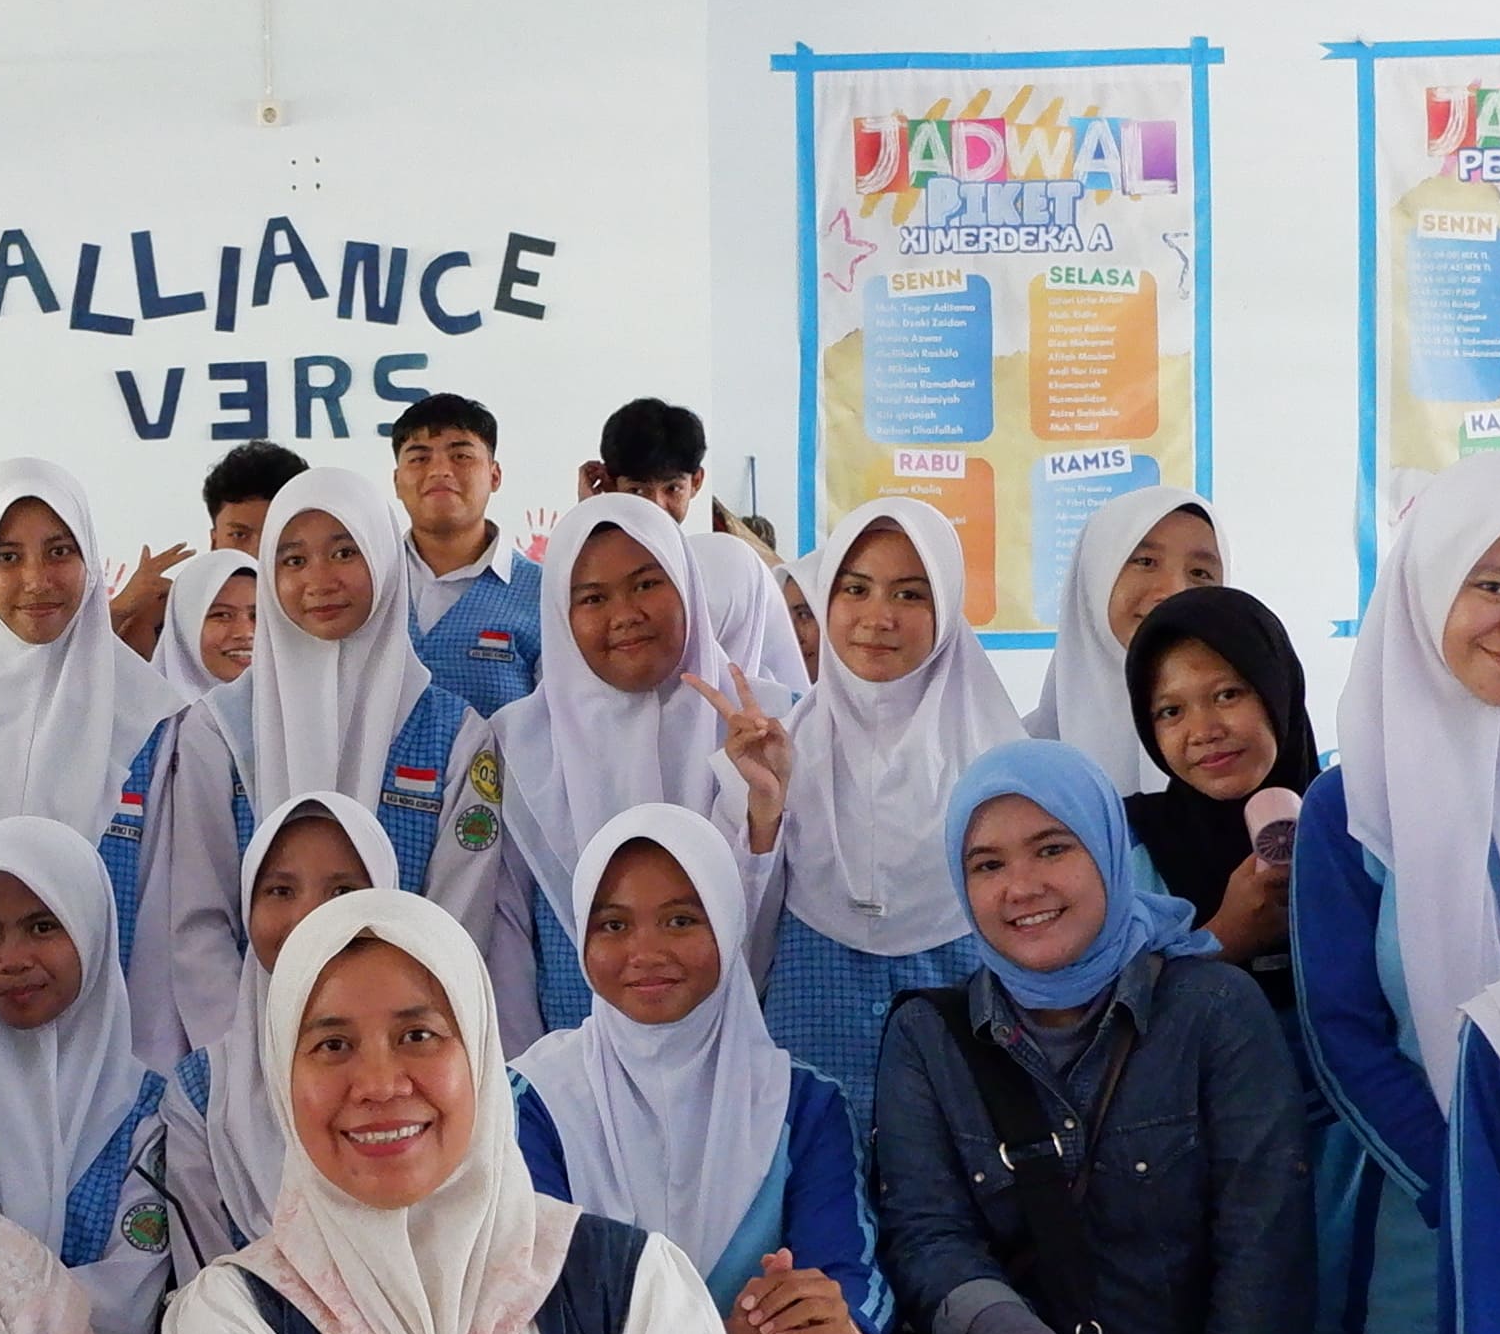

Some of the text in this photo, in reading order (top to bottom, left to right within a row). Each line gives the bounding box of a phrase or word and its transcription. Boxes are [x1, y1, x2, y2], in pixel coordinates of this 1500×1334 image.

[854, 116, 1178, 196] JADWAL
[926, 177, 1085, 228] PIKET
[1422, 214, 1493, 235] SENIN
[899, 223, 1113, 254] XI MERDEKA A
[891, 268, 963, 292] SENIN
[1049, 265, 1135, 287] SELASA
[898, 452, 960, 472] RABU
[1050, 448, 1126, 475] KAMIS
